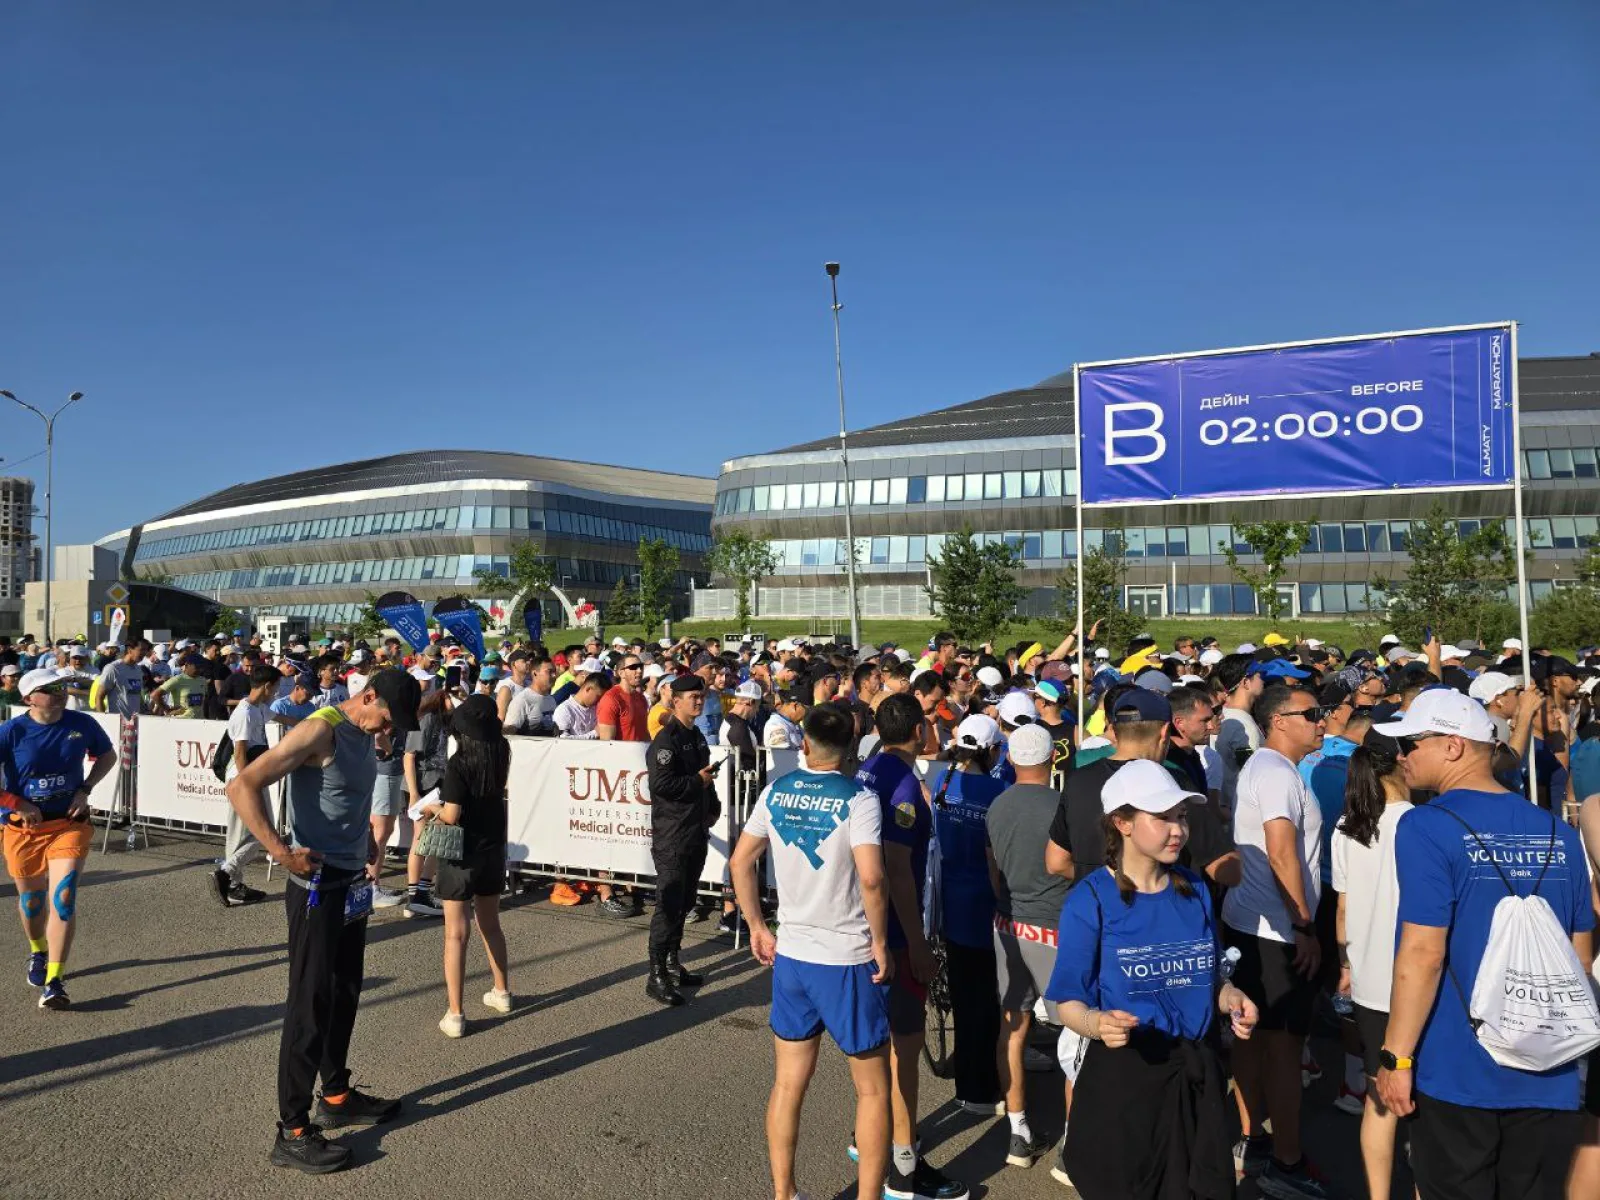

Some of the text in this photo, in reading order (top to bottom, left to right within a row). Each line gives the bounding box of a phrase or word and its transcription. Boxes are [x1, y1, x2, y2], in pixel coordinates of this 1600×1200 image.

[1491, 335, 1501, 410] MARATHON
[1351, 379, 1424, 396] BEFORE
[1199, 393, 1250, 411] ДЕЙІН
[1104, 401, 1166, 466] B
[1199, 404, 1424, 446] 02:00:00
[1482, 424, 1491, 476] ALMATY
[175, 739, 218, 770] UM
[38, 775, 66, 789] 978
[177, 783, 206, 796] Medical
[769, 792, 845, 813] FINISHER
[568, 807, 651, 821] UNIVERSIT
[569, 819, 654, 838] Medical Cente
[1467, 849, 1567, 864] VOLUNTEER
[1121, 955, 1214, 978] VOLUNTEE
